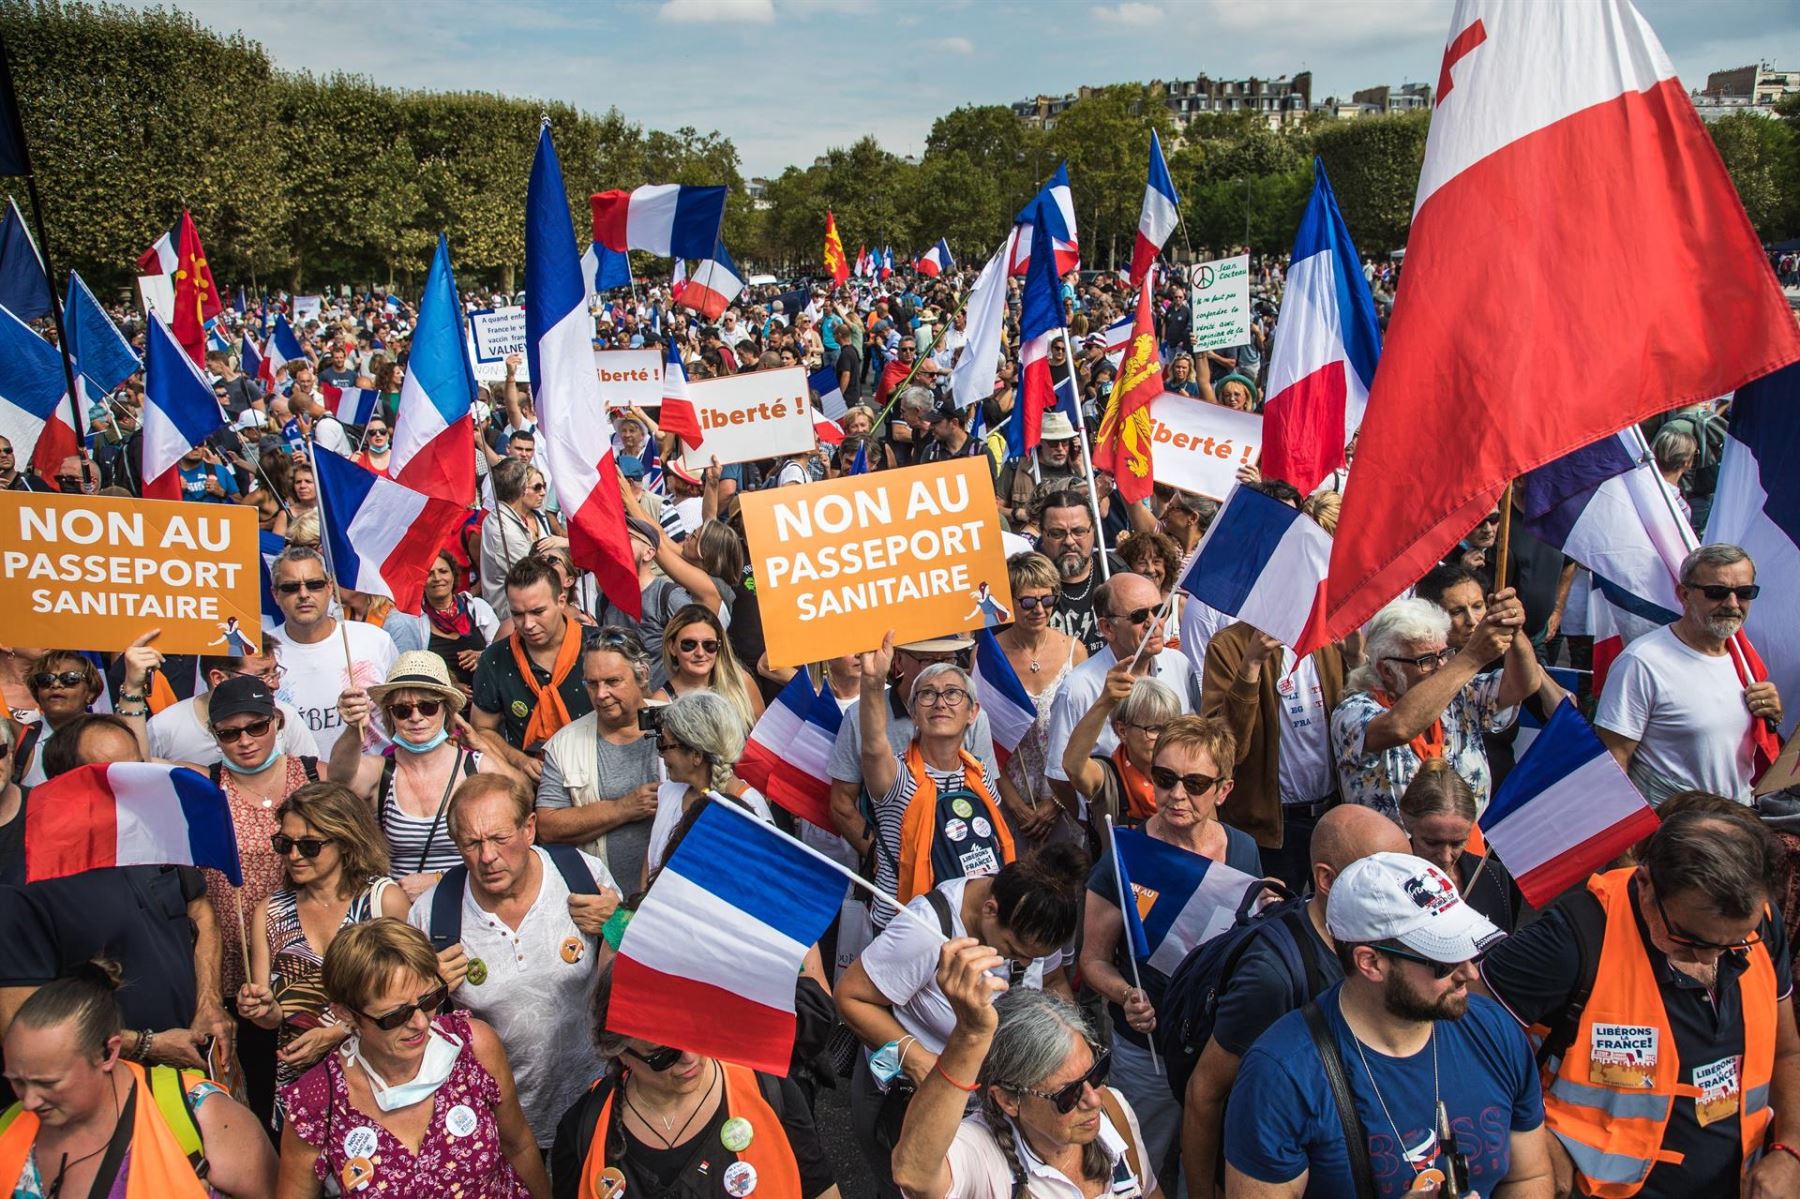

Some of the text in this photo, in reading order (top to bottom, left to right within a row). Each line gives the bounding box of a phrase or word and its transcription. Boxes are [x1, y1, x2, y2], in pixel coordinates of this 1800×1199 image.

[488, 315, 508, 323] quand
[597, 367, 659, 382] iberté !
[700, 396, 804, 430] iberté !
[1240, 445, 1253, 465] !
[773, 474, 970, 542] NON AU
[19, 506, 231, 552] NON AU
[765, 520, 985, 588] PASSEPORT
[3, 551, 242, 589] PASSEPORT
[32, 589, 219, 620] SANITAIRE
[796, 564, 971, 621] SANITAIRE
[1090, 641, 1104, 651] 1973
[1596, 1025, 1652, 1036] LIBÉRONS
[1596, 1037, 1653, 1049] FRANCE!
[1696, 1057, 1736, 1079] LIBÉRONS
[1698, 1064, 1737, 1089] FRANCE!
[347, 1132, 359, 1147] NON
[1368, 1106, 1506, 1178] BSS
